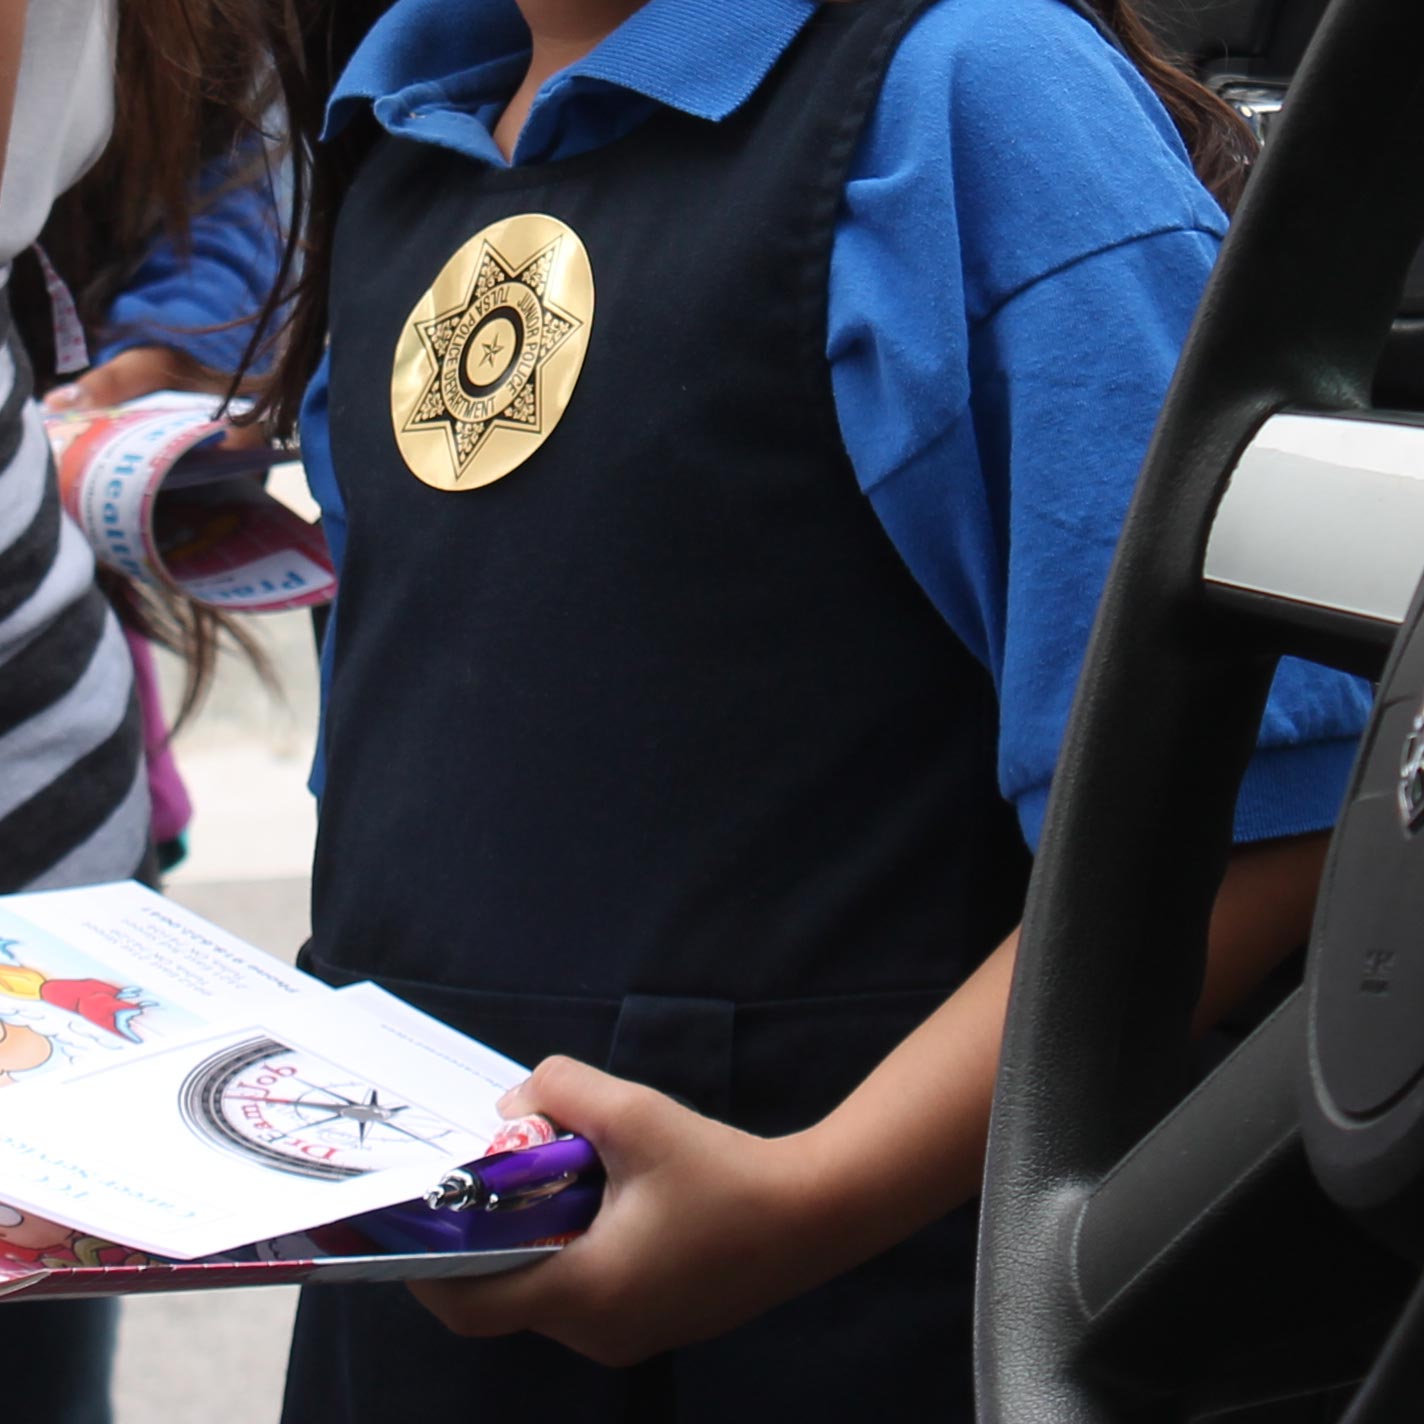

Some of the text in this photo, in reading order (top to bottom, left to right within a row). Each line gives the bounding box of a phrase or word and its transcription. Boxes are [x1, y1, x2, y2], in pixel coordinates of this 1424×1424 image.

[443, 285, 511, 419] TULSA POLICE DEPARTMENT
[506, 291, 538, 396] JUNIOR POLICE
